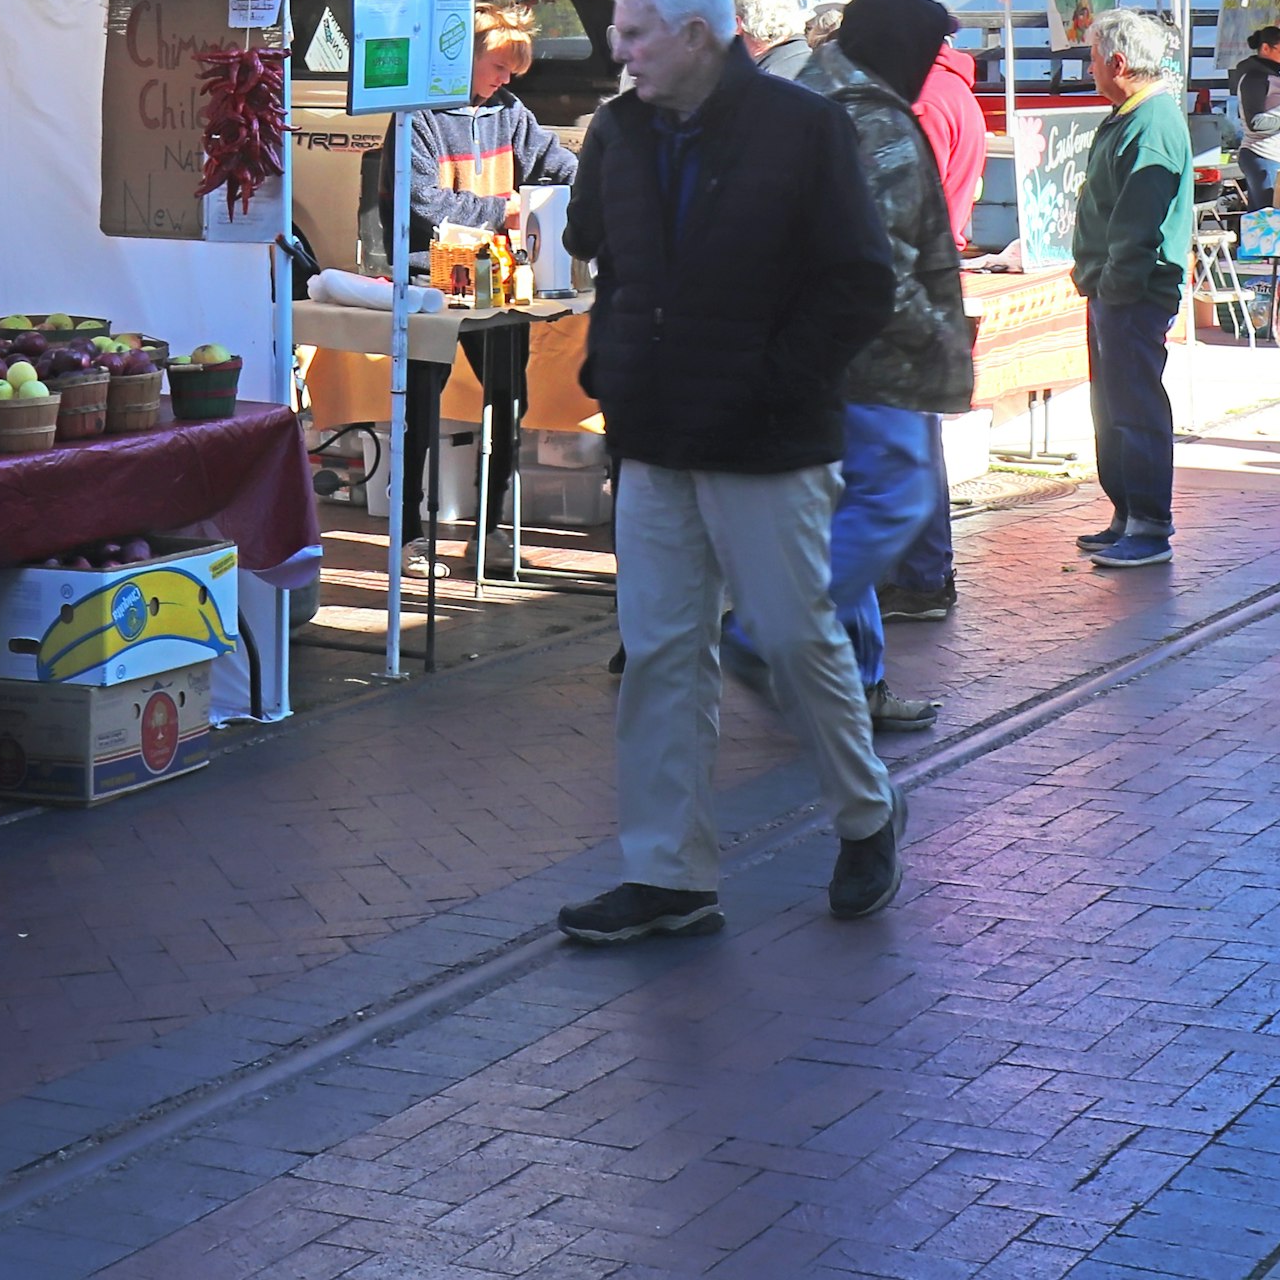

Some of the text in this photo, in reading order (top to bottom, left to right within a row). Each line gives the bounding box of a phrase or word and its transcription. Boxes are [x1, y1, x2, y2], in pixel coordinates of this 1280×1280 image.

[291, 133, 349, 152] TRD
[122, 174, 185, 233] New
[111, 586, 142, 623] Chiquita
